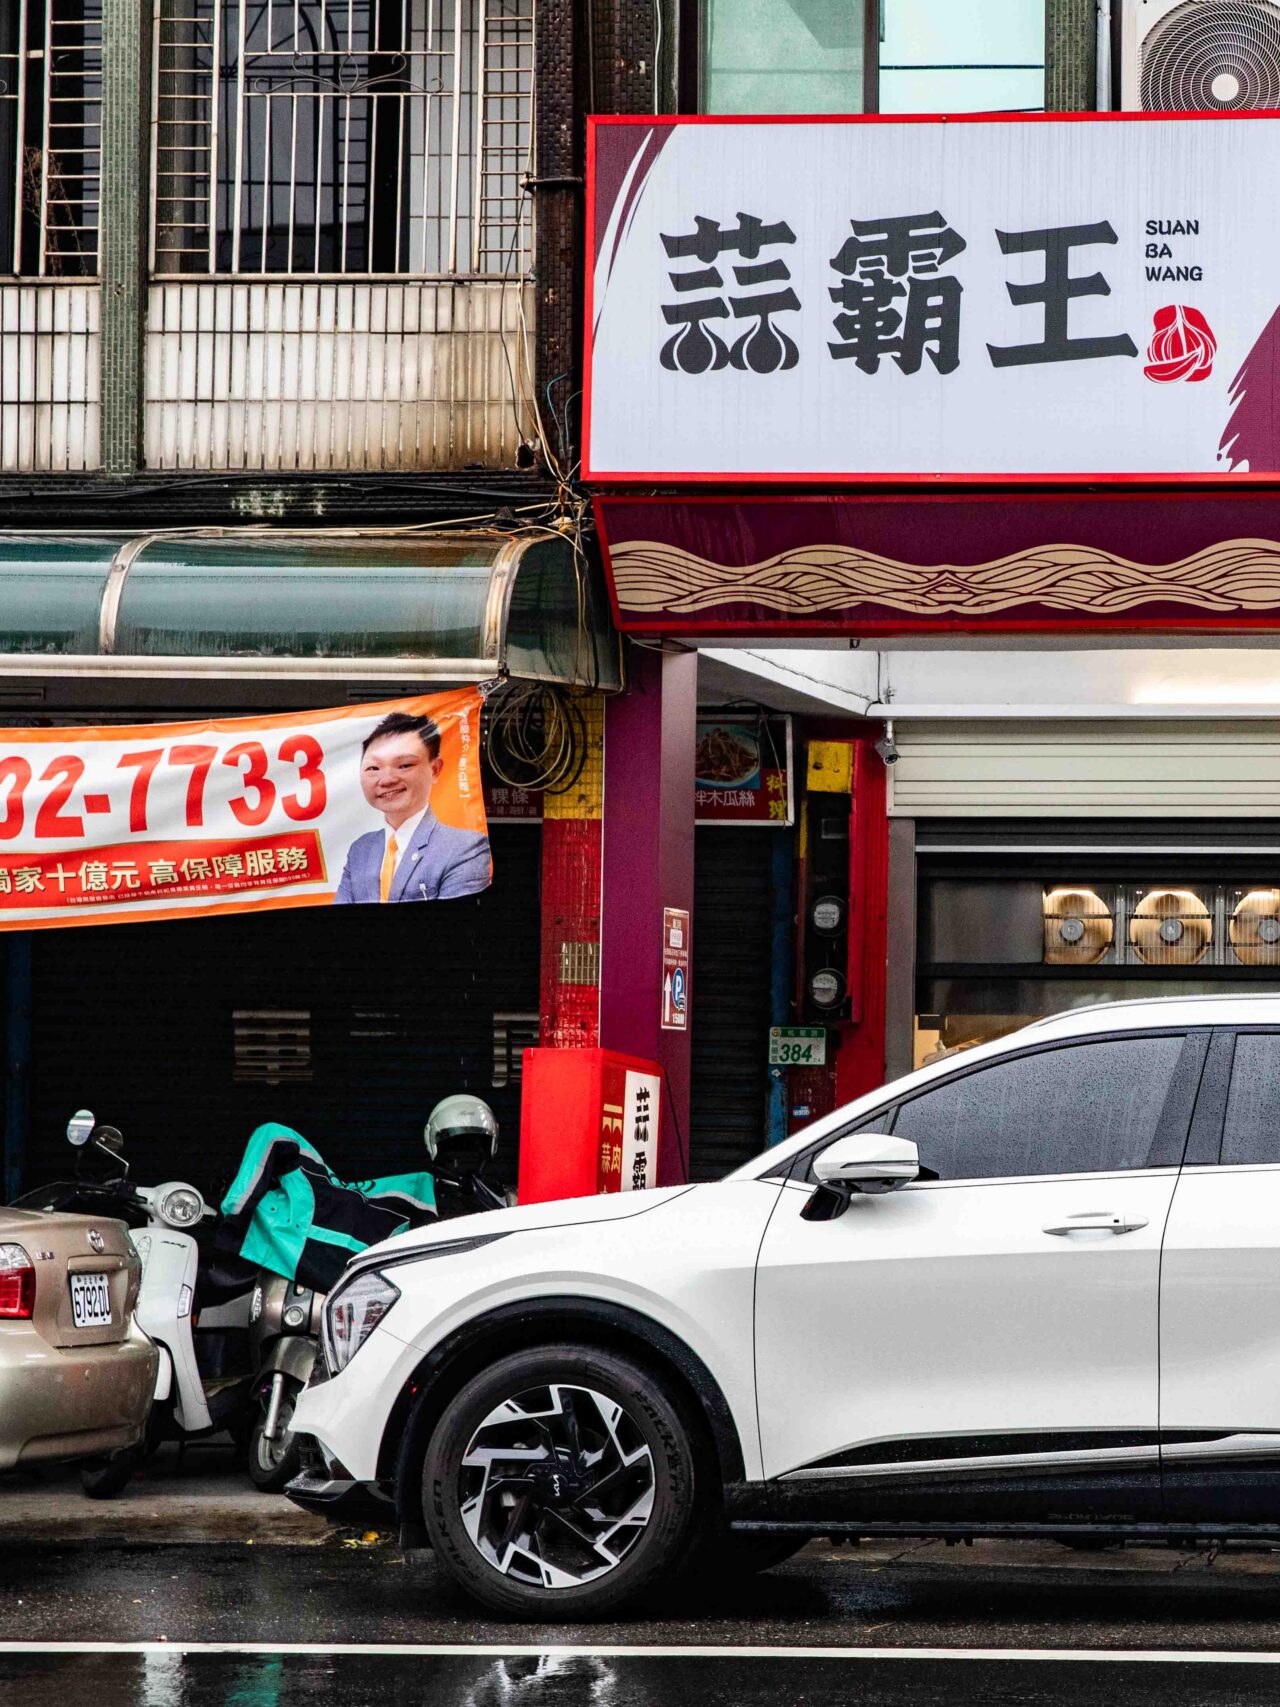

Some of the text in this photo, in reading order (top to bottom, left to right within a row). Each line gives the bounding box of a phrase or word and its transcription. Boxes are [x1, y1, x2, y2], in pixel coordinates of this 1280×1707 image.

[1145, 220, 1200, 236] SUAN
[1145, 244, 1173, 259] BA
[1145, 266, 1203, 282] WANG
[660, 210, 1138, 375] 蒜霸王
[148, 846, 308, 885] 高保障服務
[780, 1044, 813, 1062] 384
